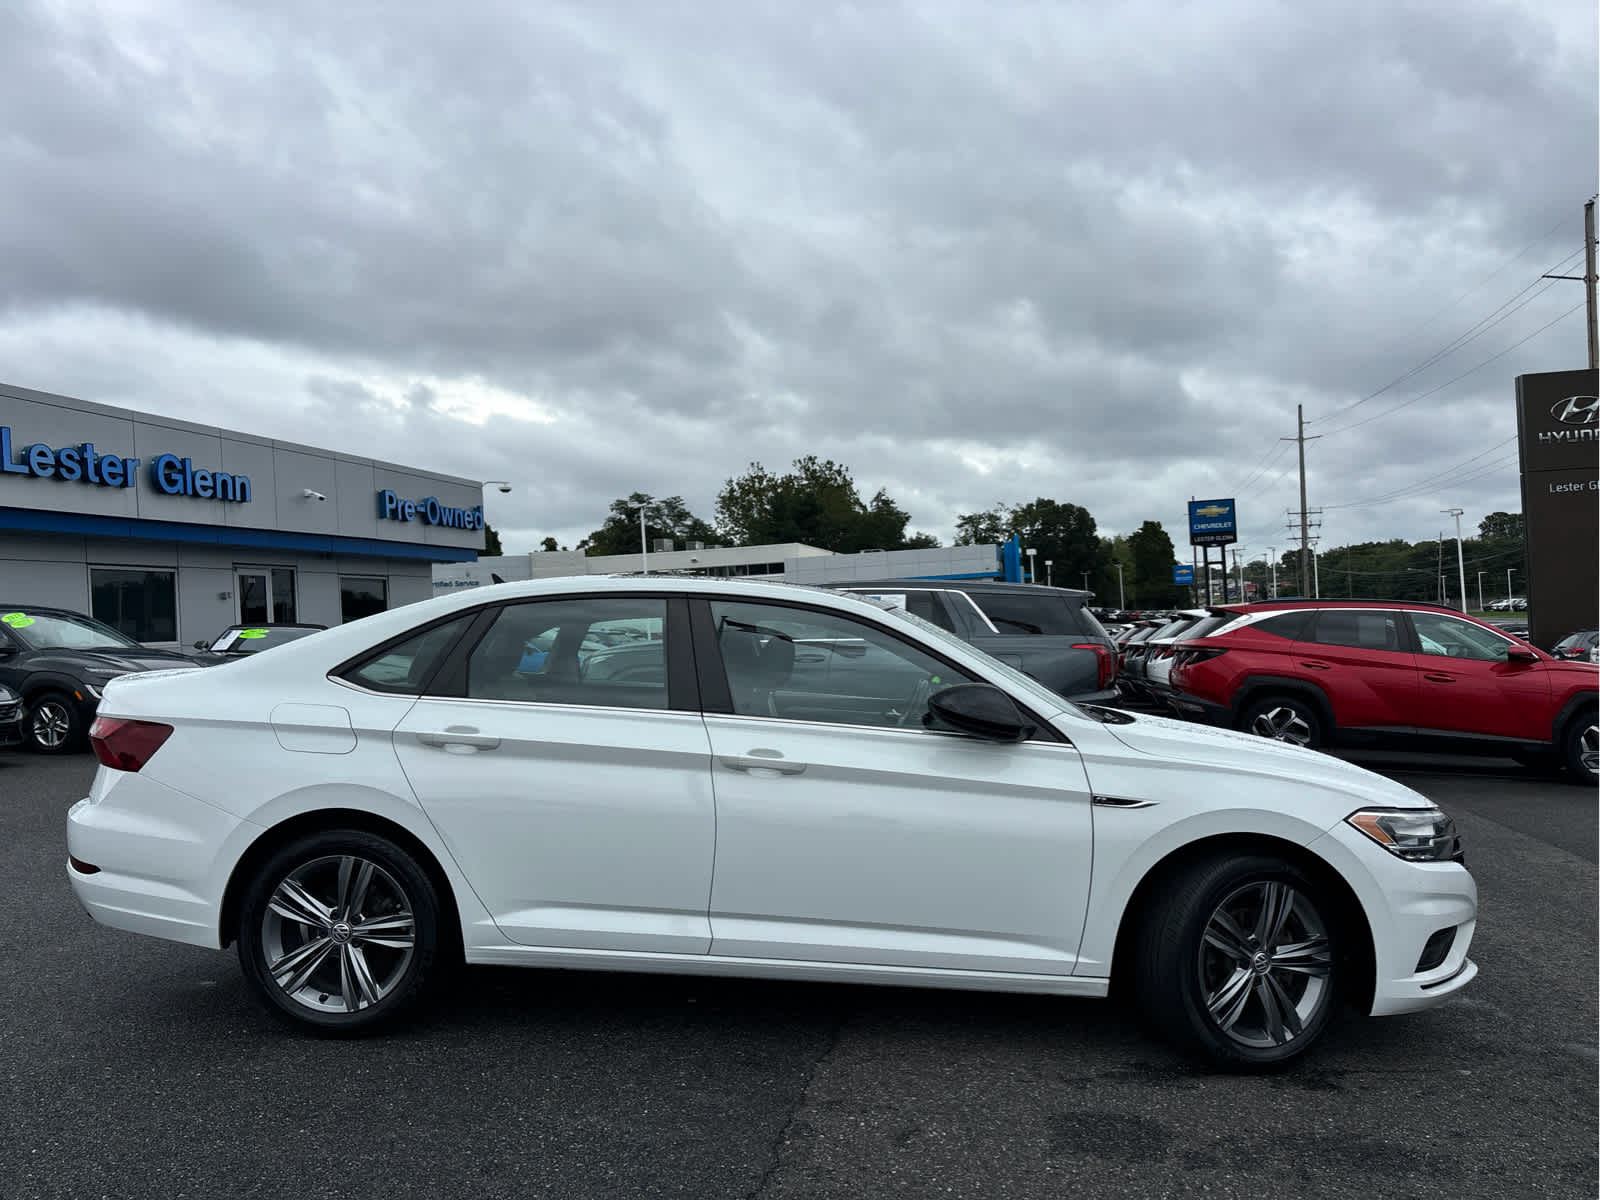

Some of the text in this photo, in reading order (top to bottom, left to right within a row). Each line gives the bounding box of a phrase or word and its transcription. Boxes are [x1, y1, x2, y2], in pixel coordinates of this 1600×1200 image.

[0, 426, 251, 503] Lester Glenn
[1549, 482, 1585, 493] Lester
[379, 489, 483, 530] Pre-Owned
[1193, 521, 1233, 530] CHEVROLET
